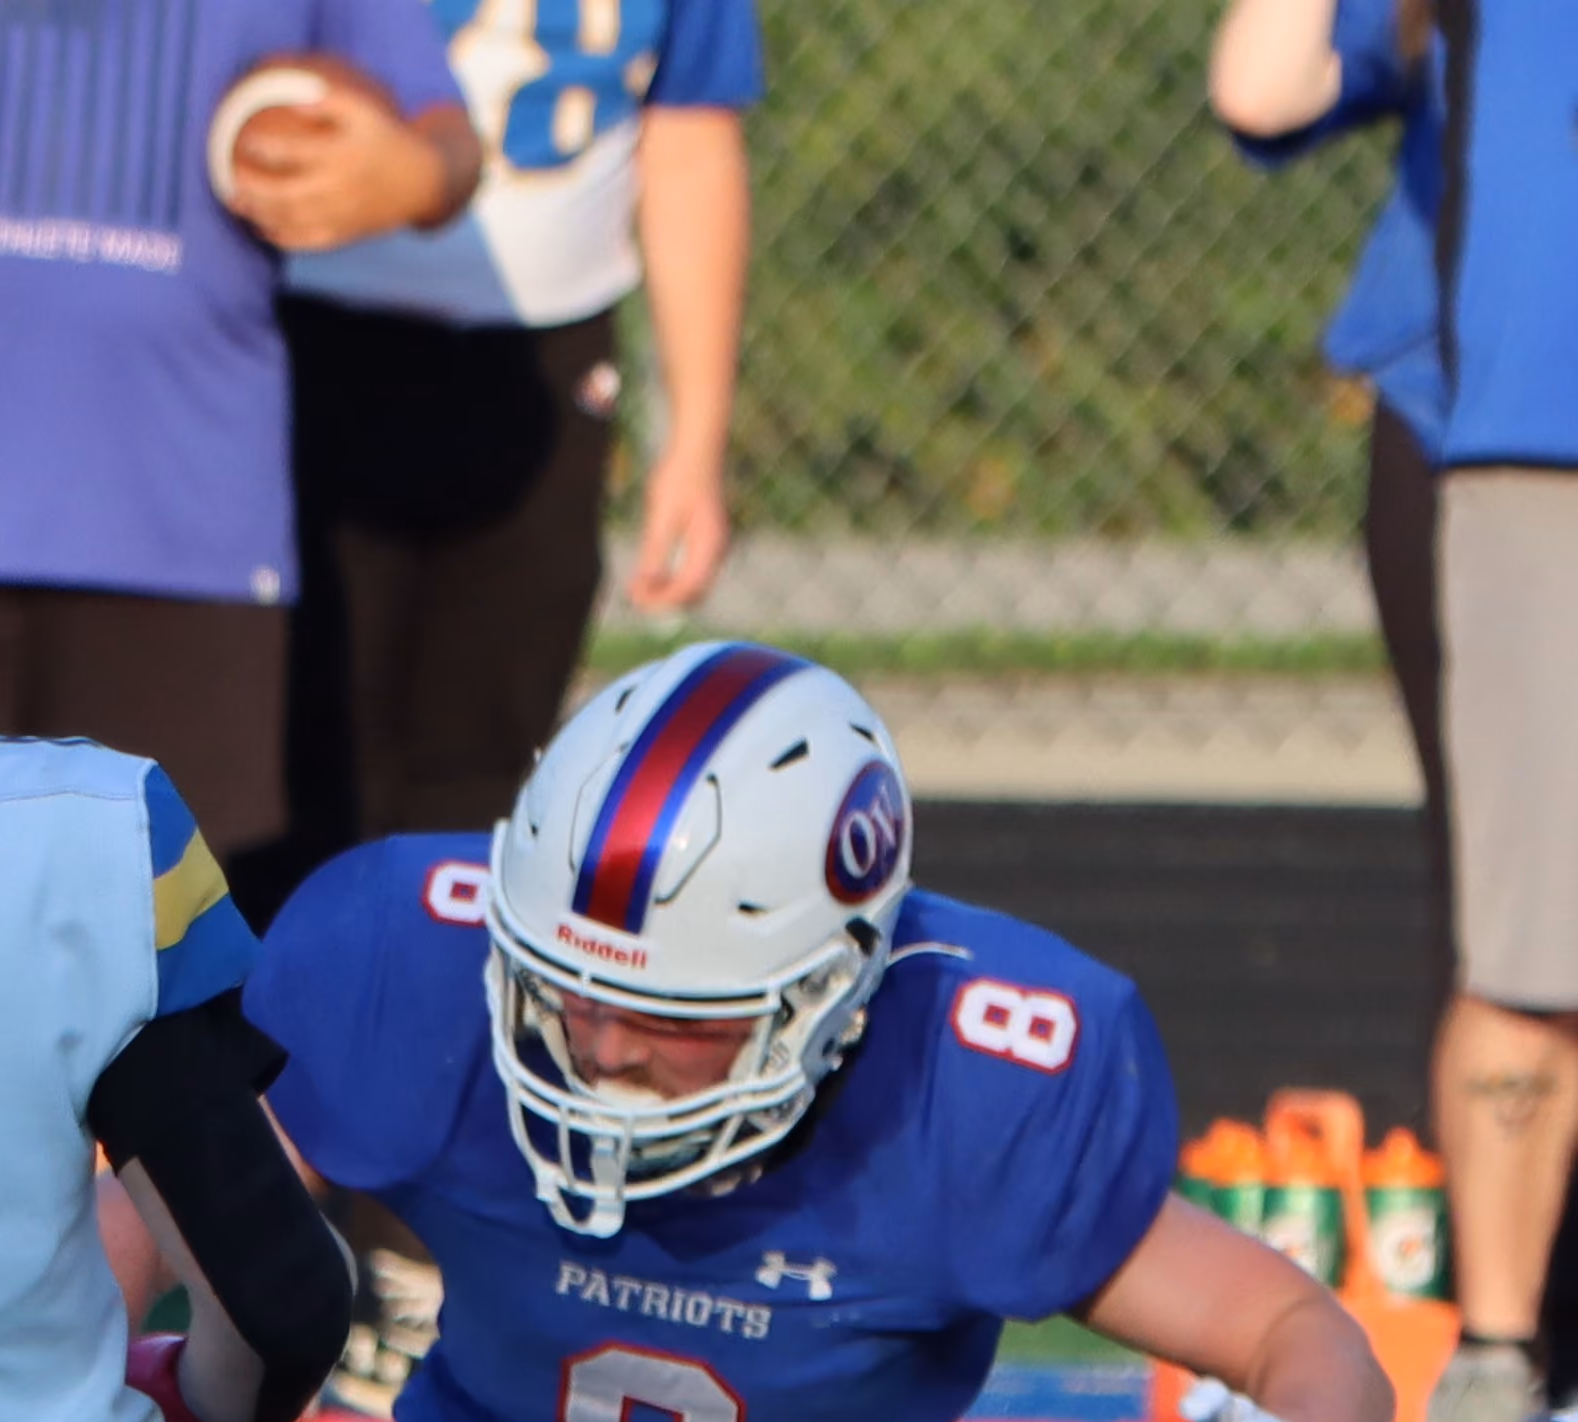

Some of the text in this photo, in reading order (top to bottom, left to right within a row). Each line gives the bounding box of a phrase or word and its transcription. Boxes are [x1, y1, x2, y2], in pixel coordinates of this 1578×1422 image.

[555, 922, 648, 970] Riddell
[948, 975, 1082, 1077] 8
[554, 1258, 772, 1340] PATRIOTS
